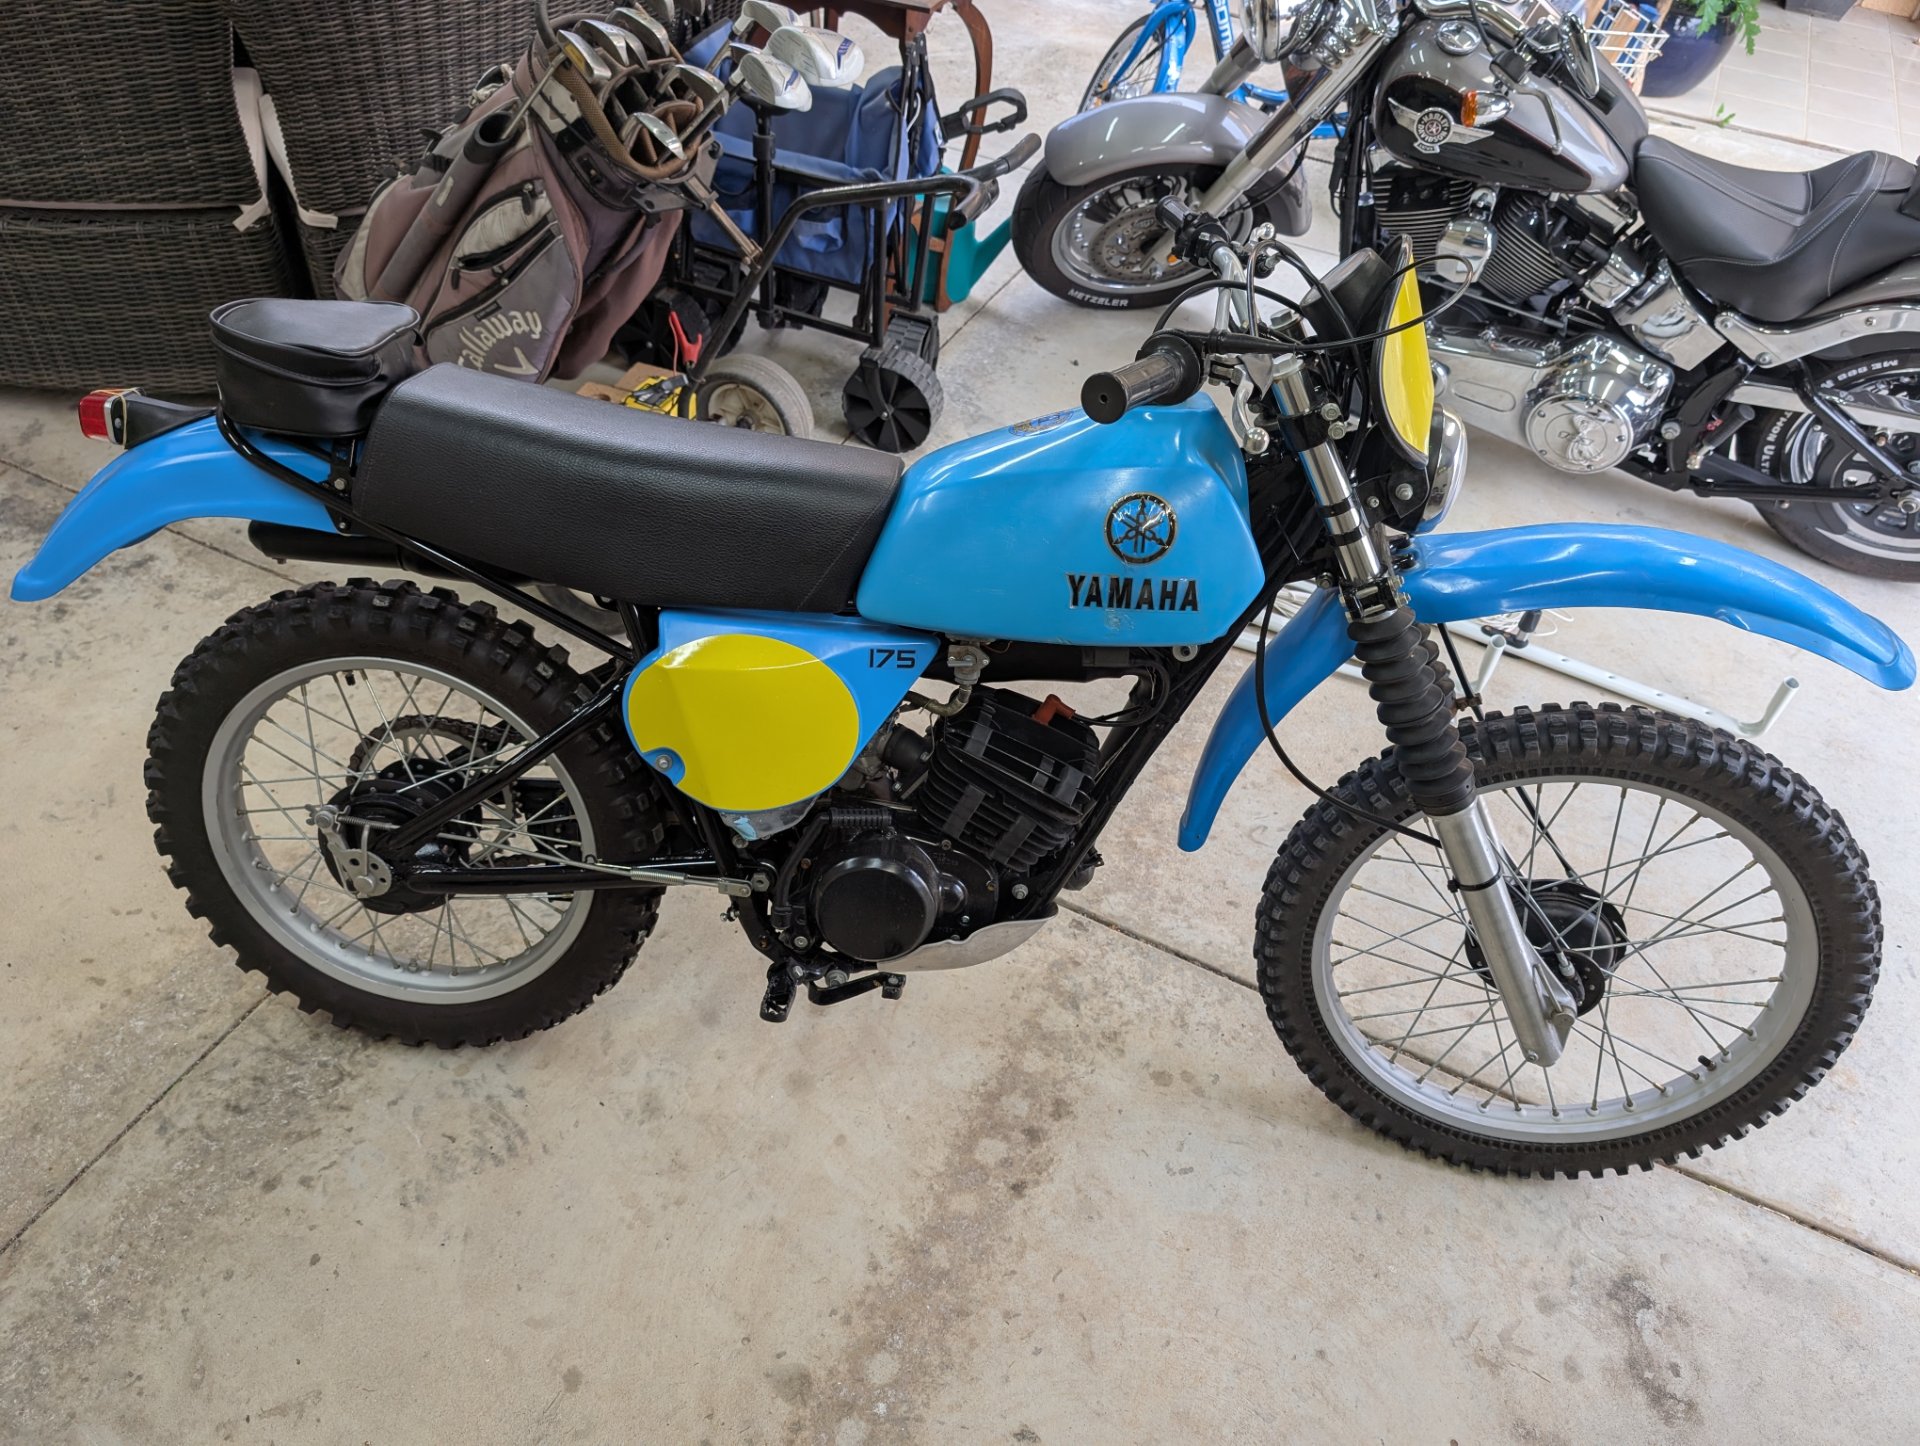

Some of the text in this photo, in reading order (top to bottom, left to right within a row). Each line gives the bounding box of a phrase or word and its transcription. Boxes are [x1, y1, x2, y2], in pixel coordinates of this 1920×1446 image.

[1067, 288, 1129, 307] METZELER
[458, 310, 542, 371] allaway
[1066, 574, 1199, 612] YAMAHA
[869, 648, 917, 669] 175
